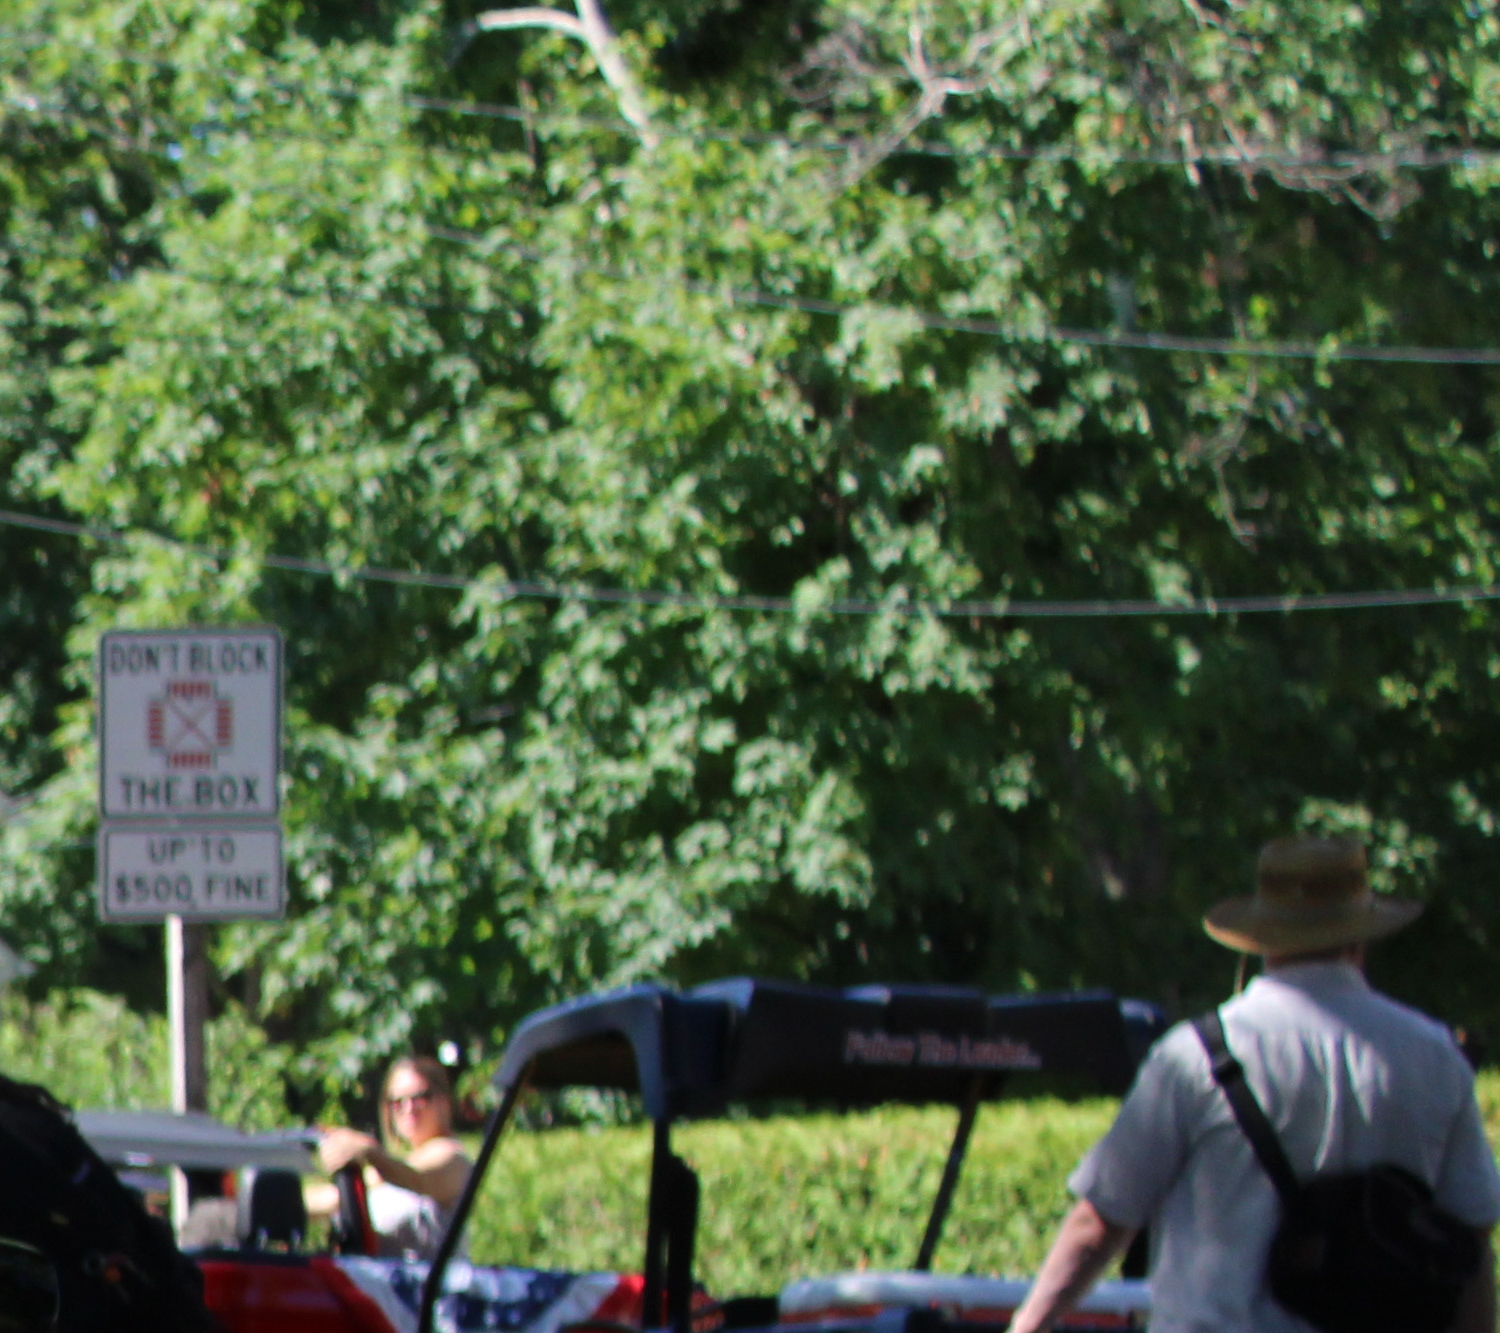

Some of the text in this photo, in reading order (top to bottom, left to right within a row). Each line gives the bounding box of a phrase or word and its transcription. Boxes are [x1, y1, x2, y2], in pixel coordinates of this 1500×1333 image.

[190, 643, 268, 673] BLOCK
[120, 776, 260, 806] THE BOX
[147, 838, 236, 865] UP TO
[115, 874, 270, 903] $500 FINE
